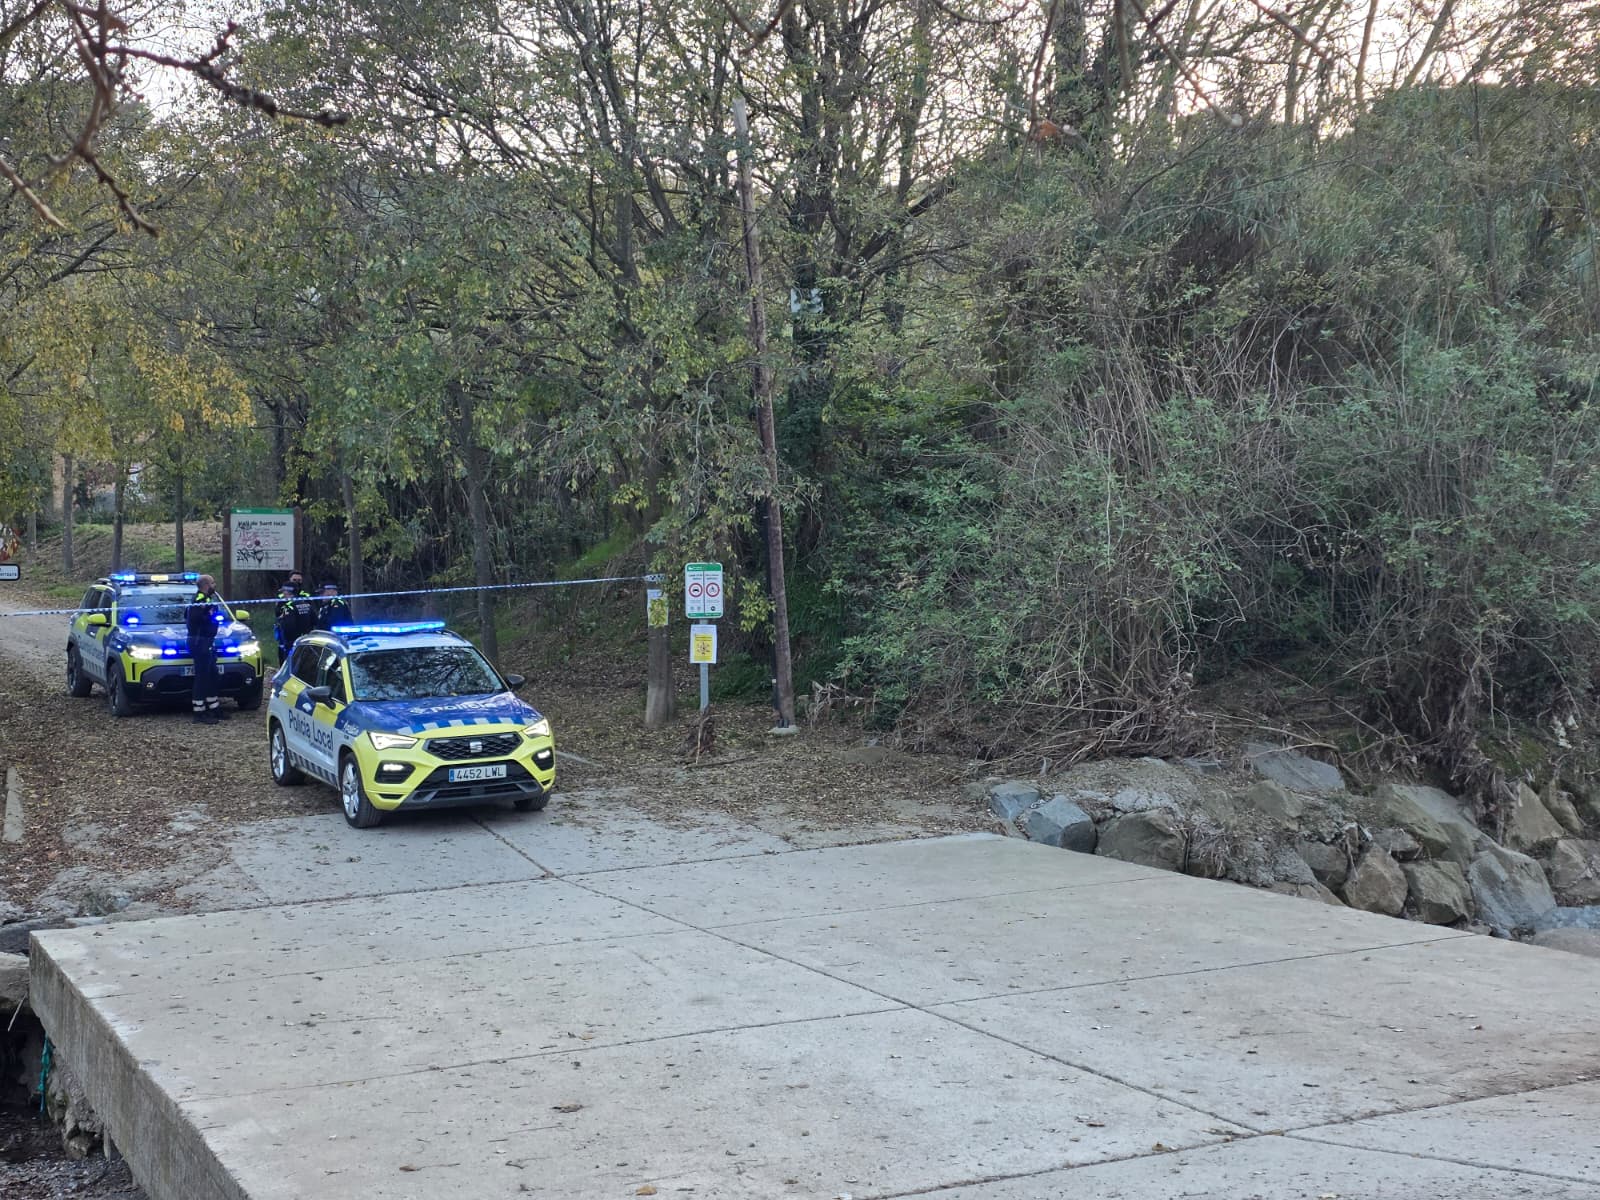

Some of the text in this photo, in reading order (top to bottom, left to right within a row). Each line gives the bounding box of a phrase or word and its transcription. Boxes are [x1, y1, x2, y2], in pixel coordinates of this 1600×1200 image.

[312, 719, 335, 752] Local
[456, 767, 504, 780] 4452 LWL
